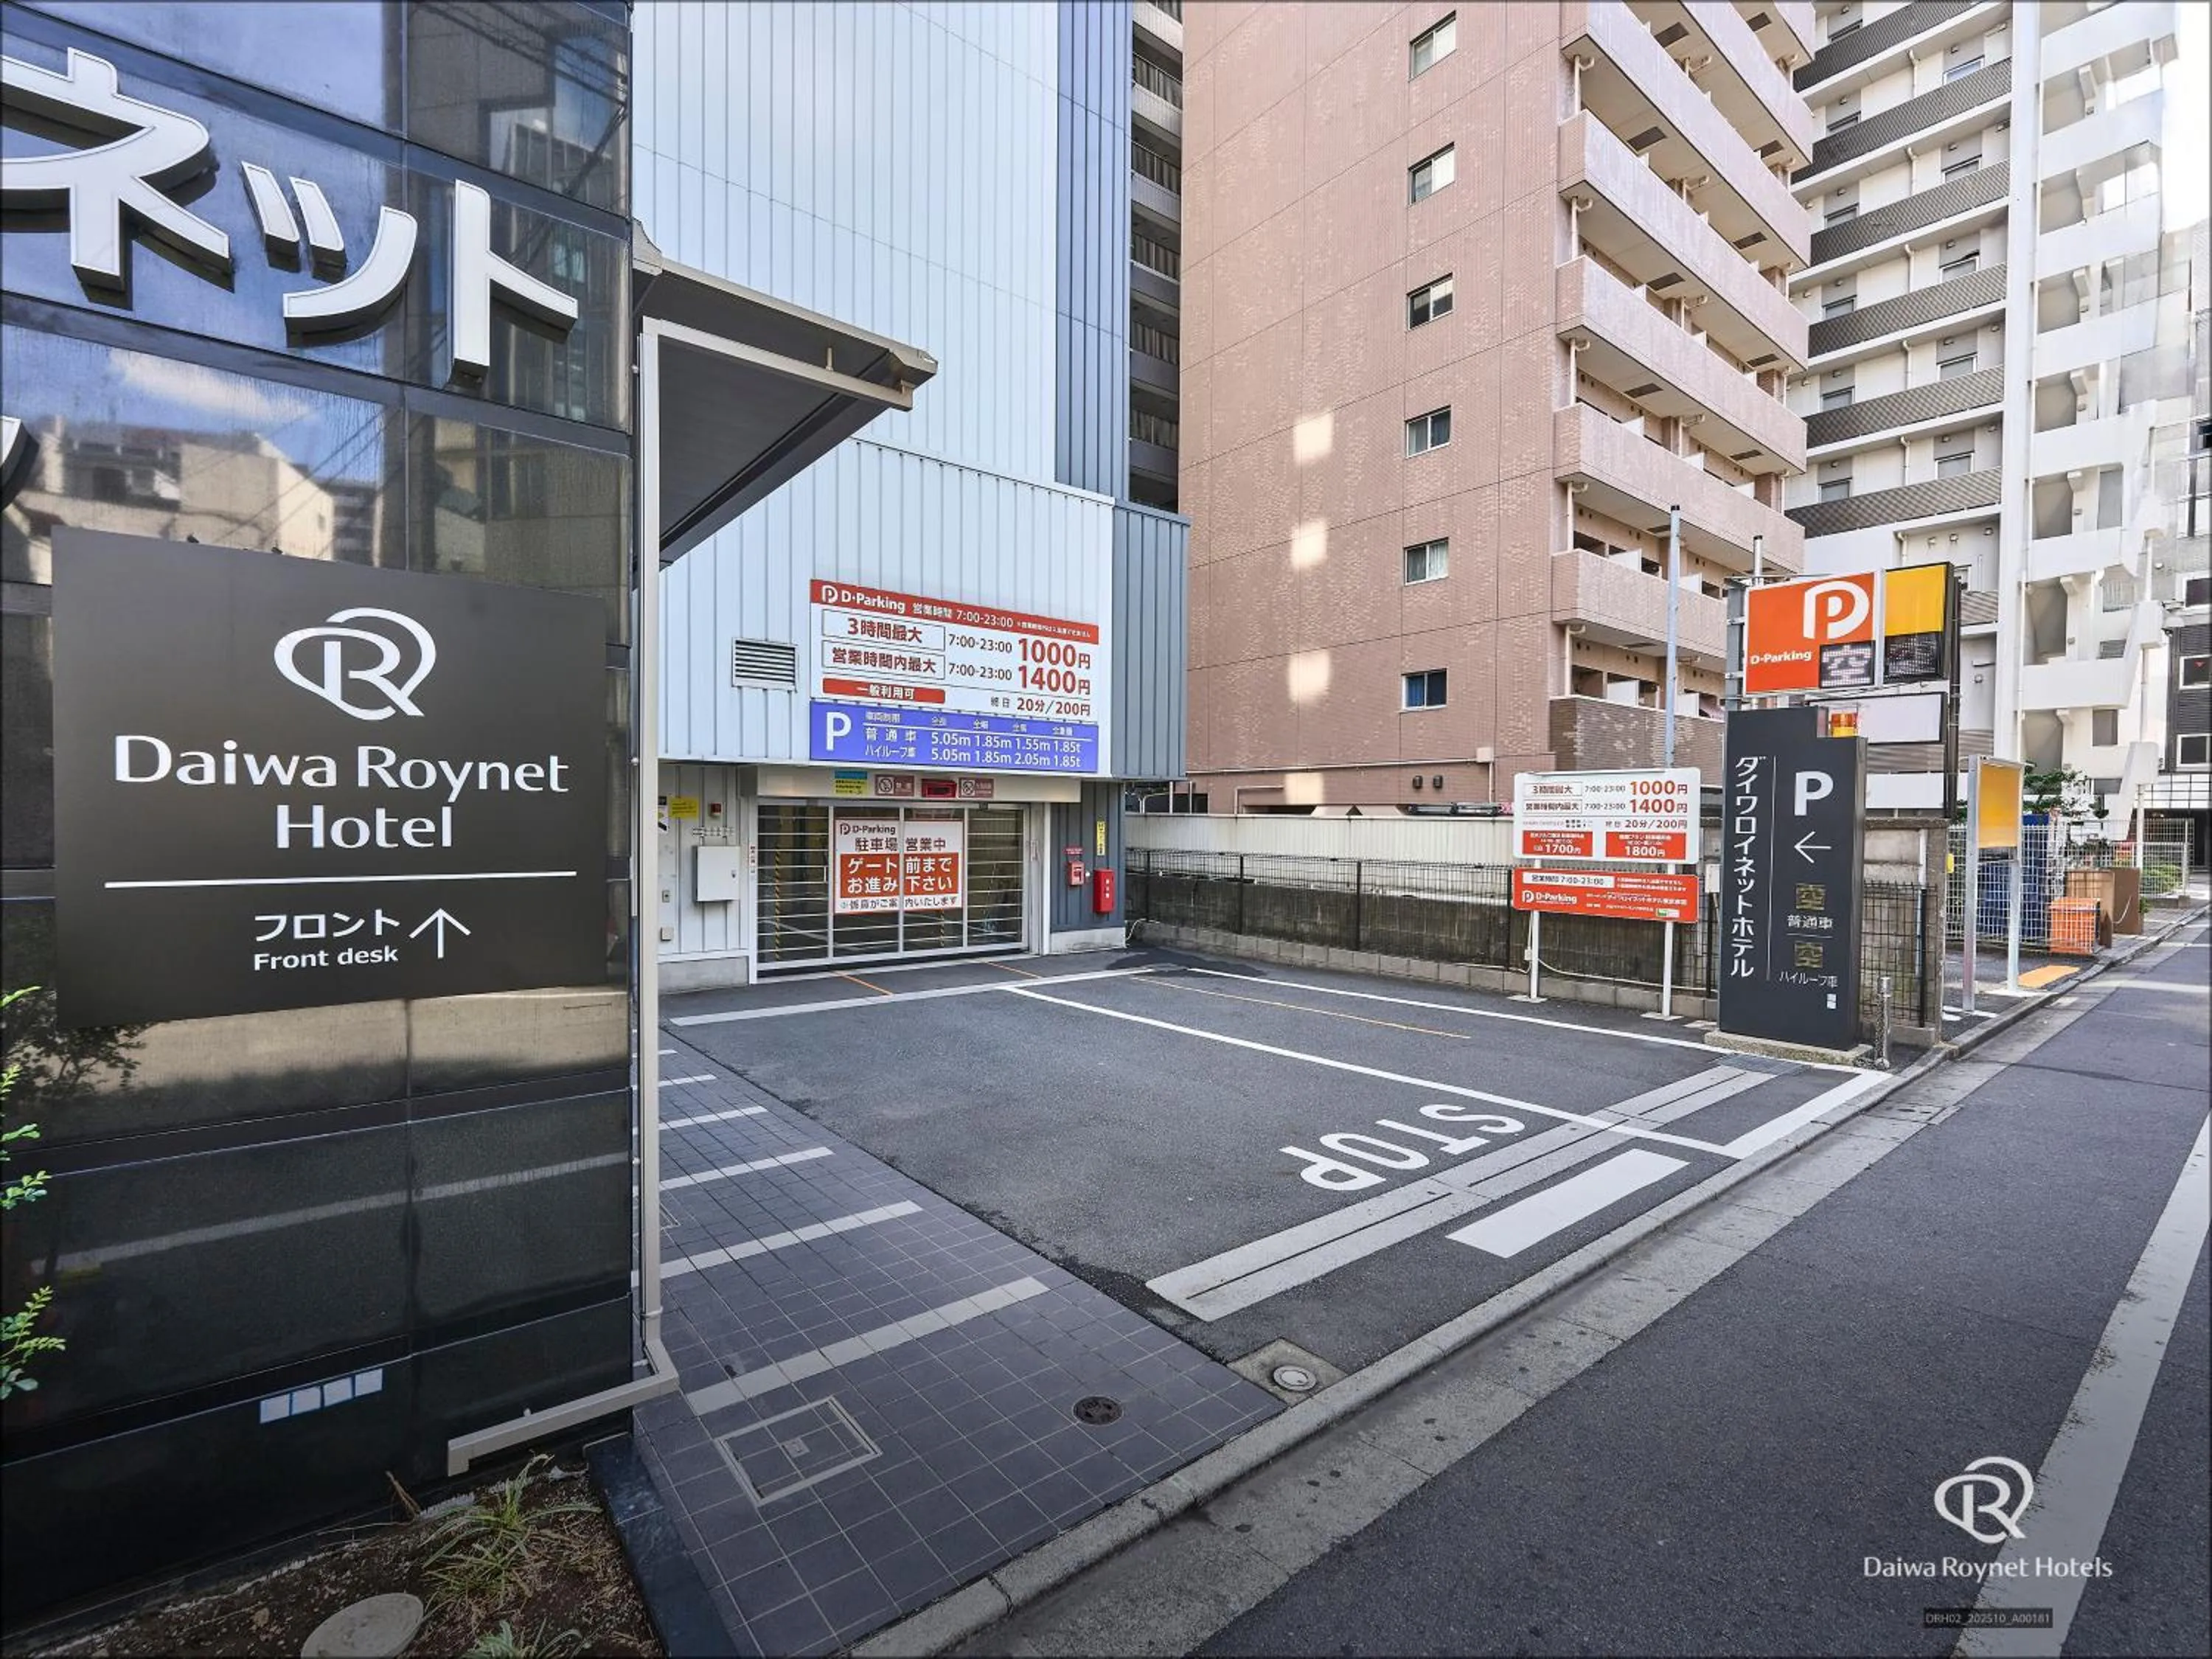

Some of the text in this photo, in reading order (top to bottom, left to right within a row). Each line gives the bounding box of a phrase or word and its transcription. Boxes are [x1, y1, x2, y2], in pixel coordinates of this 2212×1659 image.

[0, 47, 577, 369] ネット
[841, 592, 906, 614] D-Parking
[956, 610, 1014, 627] 7:00-23:00
[847, 617, 1091, 669] 3時間最大 7:00-23:00 1000円
[1750, 650, 1812, 665] D-Parking
[832, 647, 1091, 695] 営業時間内最大 7:00-23:00 1400円
[857, 684, 915, 700] 一般利用可
[826, 712, 852, 751] P
[931, 732, 970, 747] 5.05m
[975, 735, 1012, 749] 1.85m
[1016, 738, 1050, 751] 1.55m
[1054, 740, 1080, 753] 1.85t
[114, 735, 569, 802] Daiwa Roynet
[931, 748, 970, 762] 5.05m
[975, 751, 1012, 764] 1.85m
[1015, 754, 1050, 766] 2.05m
[1054, 756, 1080, 768] 1.85t
[1630, 780, 1688, 795] 1000円
[1794, 770, 1833, 816] P
[1630, 799, 1688, 813] 1400円
[276, 804, 453, 849] Hotel
[852, 824, 896, 835] D-Parking
[1624, 846, 1666, 857] 1800円
[1731, 756, 1767, 978] ダイワロイネットホテル
[254, 908, 400, 942] フロント
[1787, 914, 1834, 930] 普通車
[254, 945, 399, 971] Front desk
[1779, 971, 1838, 989] ハイルーフ車
[1279, 1104, 1526, 1191] STOP
